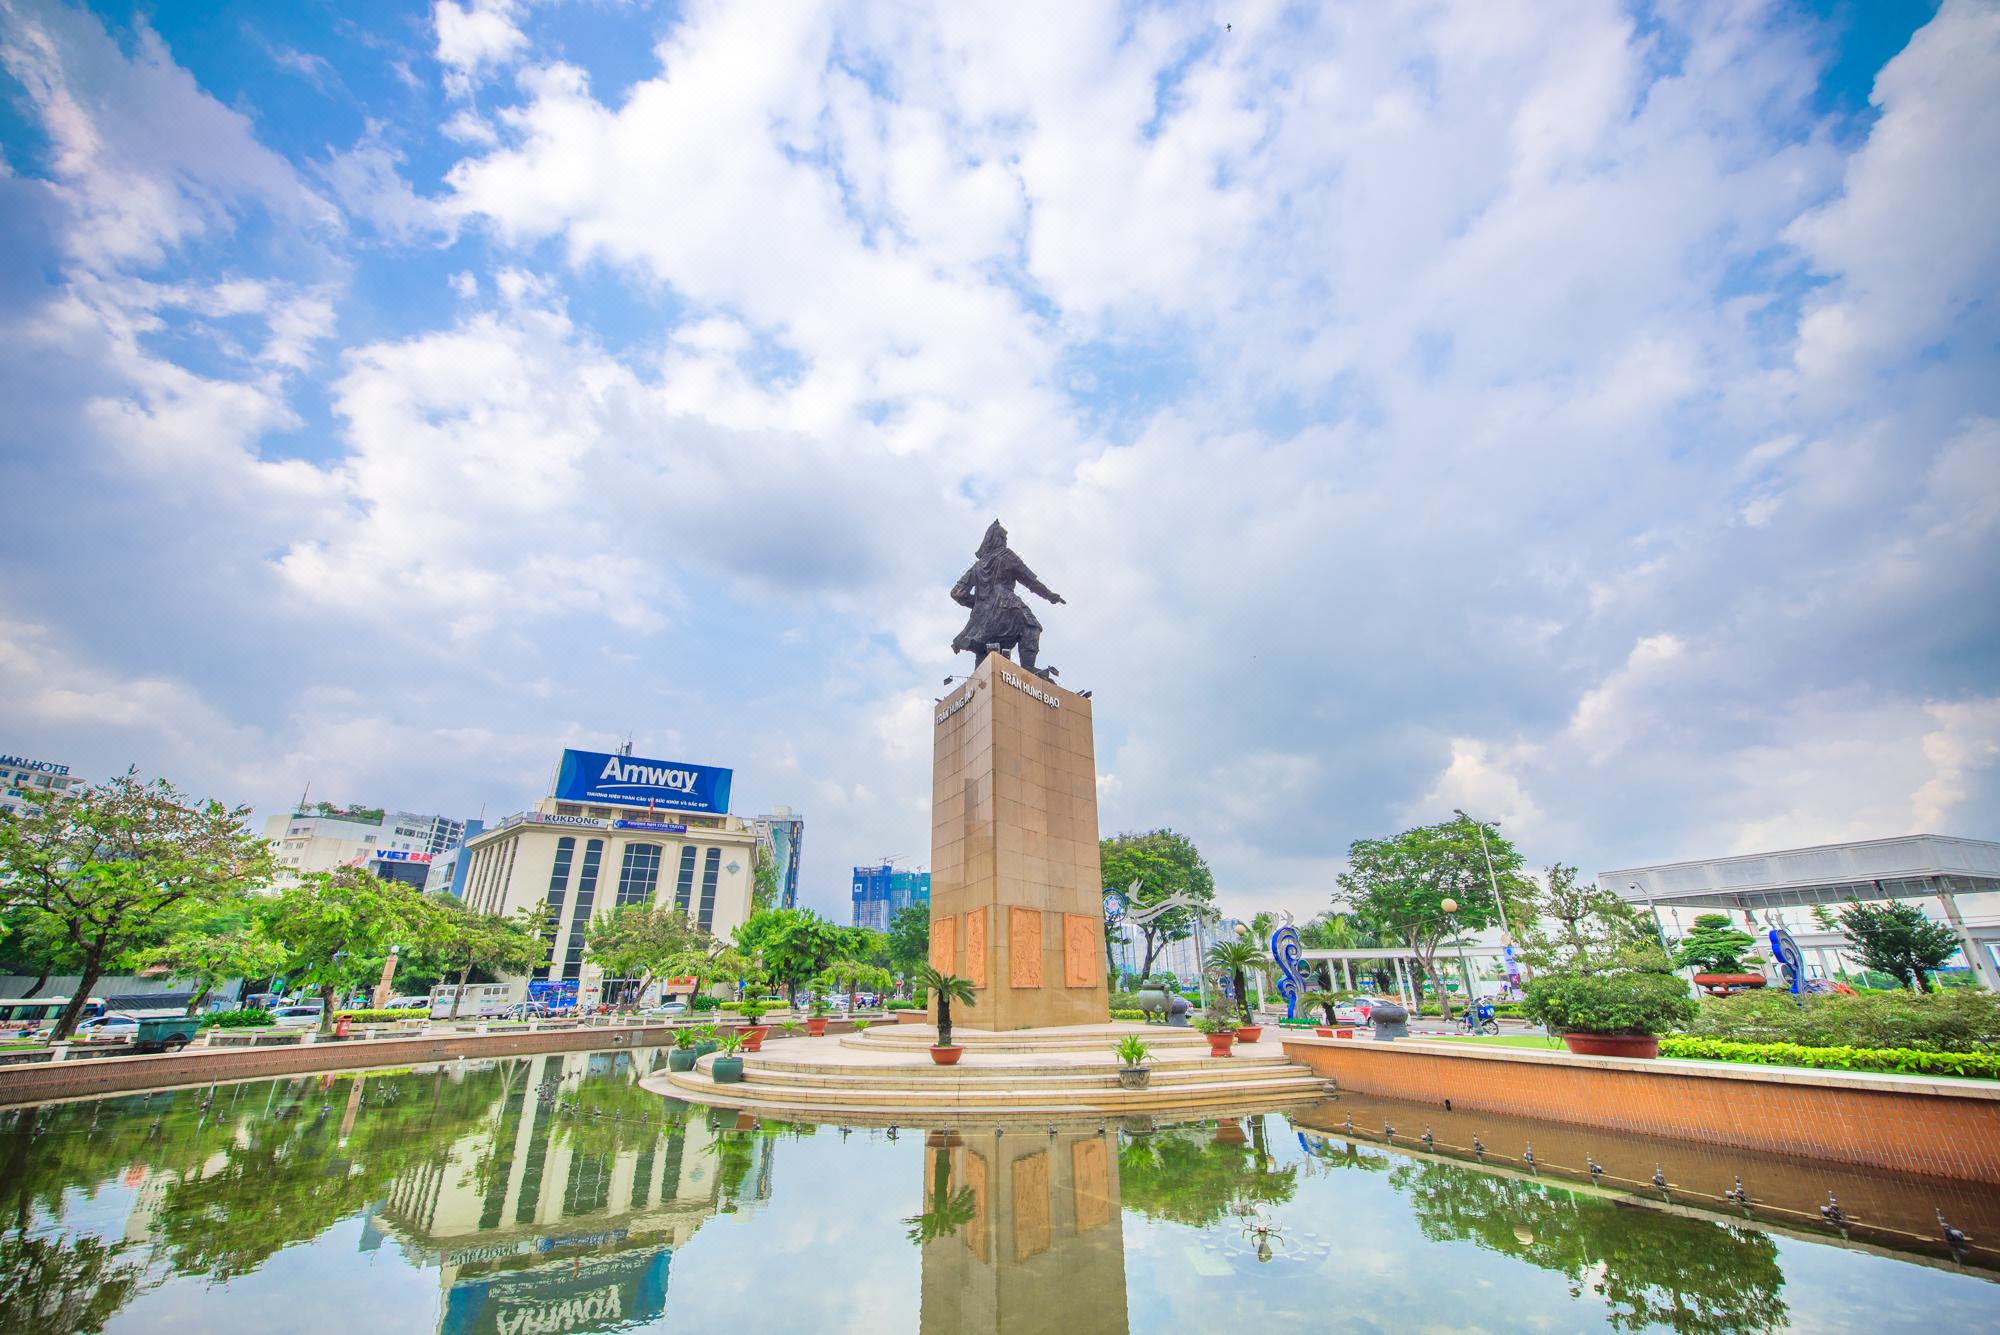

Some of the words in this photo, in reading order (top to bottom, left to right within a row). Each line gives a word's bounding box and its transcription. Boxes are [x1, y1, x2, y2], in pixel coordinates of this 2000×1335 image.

[1044, 694, 1060, 708] ĐẠO
[600, 756, 698, 793] Amway
[544, 814, 600, 825] KUKDONG
